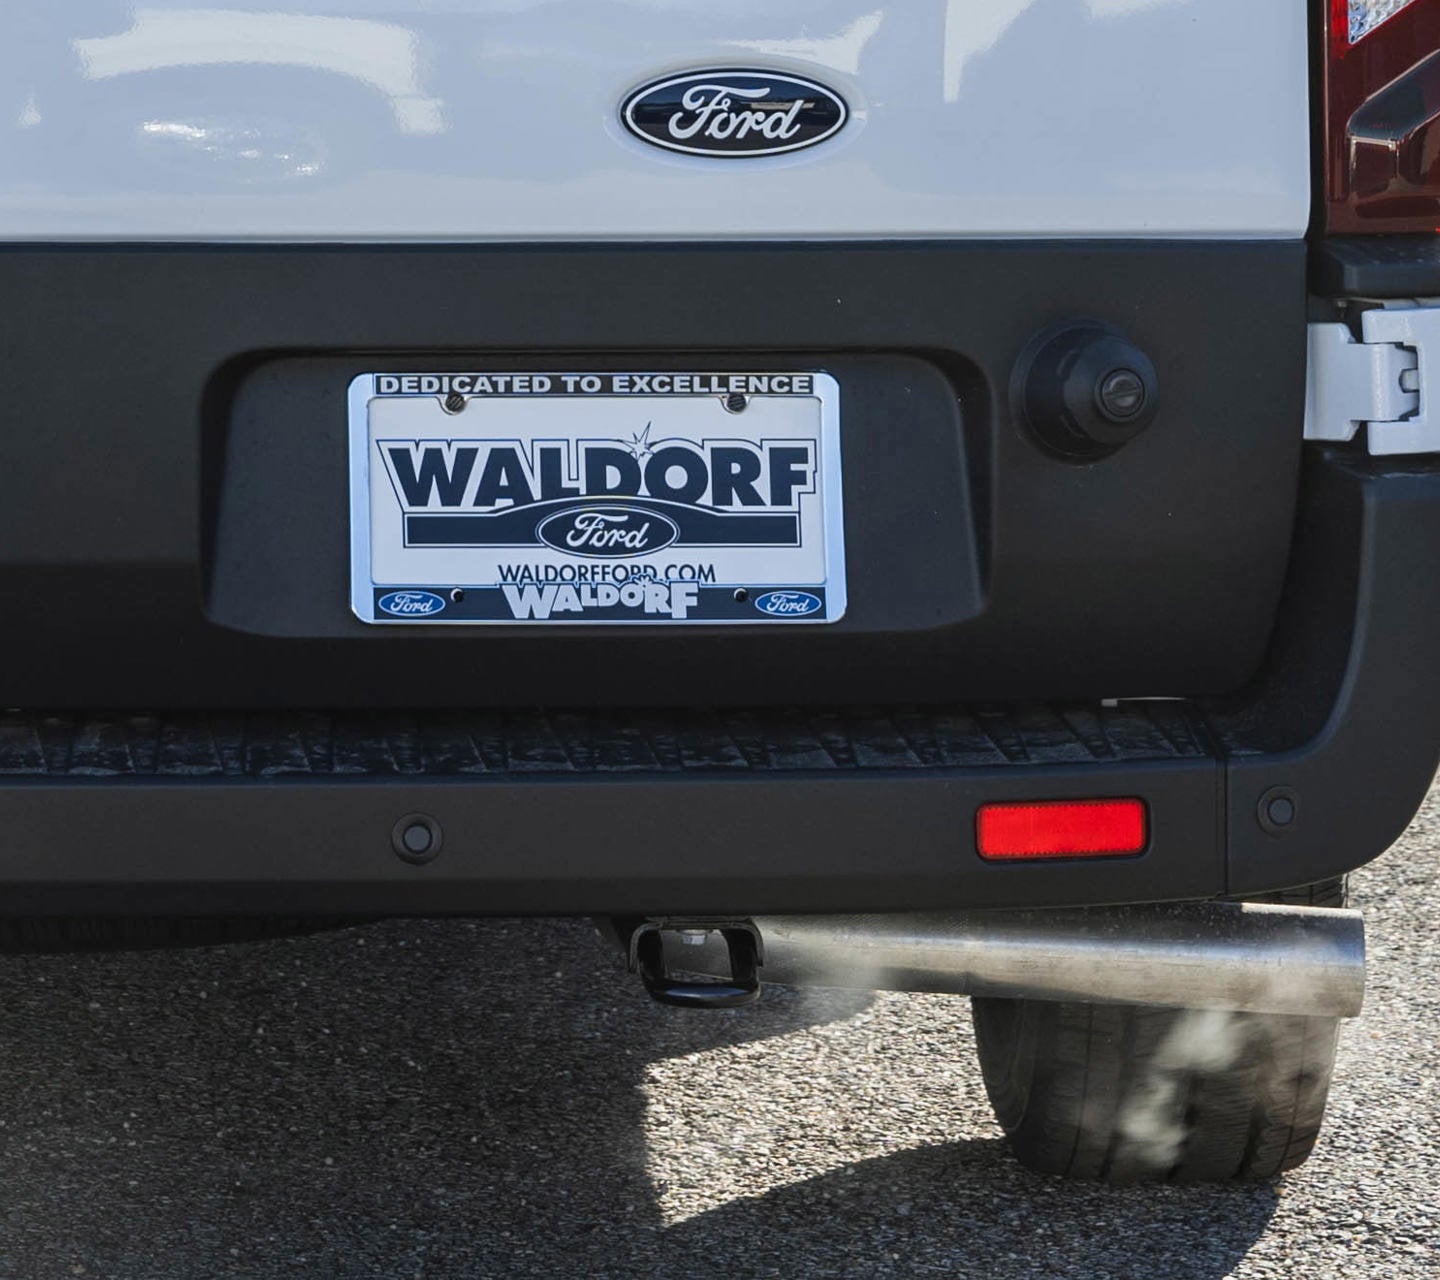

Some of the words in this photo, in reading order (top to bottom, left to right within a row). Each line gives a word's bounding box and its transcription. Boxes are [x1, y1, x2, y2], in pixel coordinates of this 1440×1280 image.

[668, 84, 804, 139] Ford
[379, 376, 552, 394] DEDICATED
[560, 376, 602, 393] TO
[612, 375, 811, 393] EXCELLENCE
[384, 444, 812, 509] WALDORF
[565, 512, 649, 549] Ford
[390, 595, 435, 615] Ford
[500, 581, 700, 619] WALDORF
[766, 594, 811, 615] Ford
